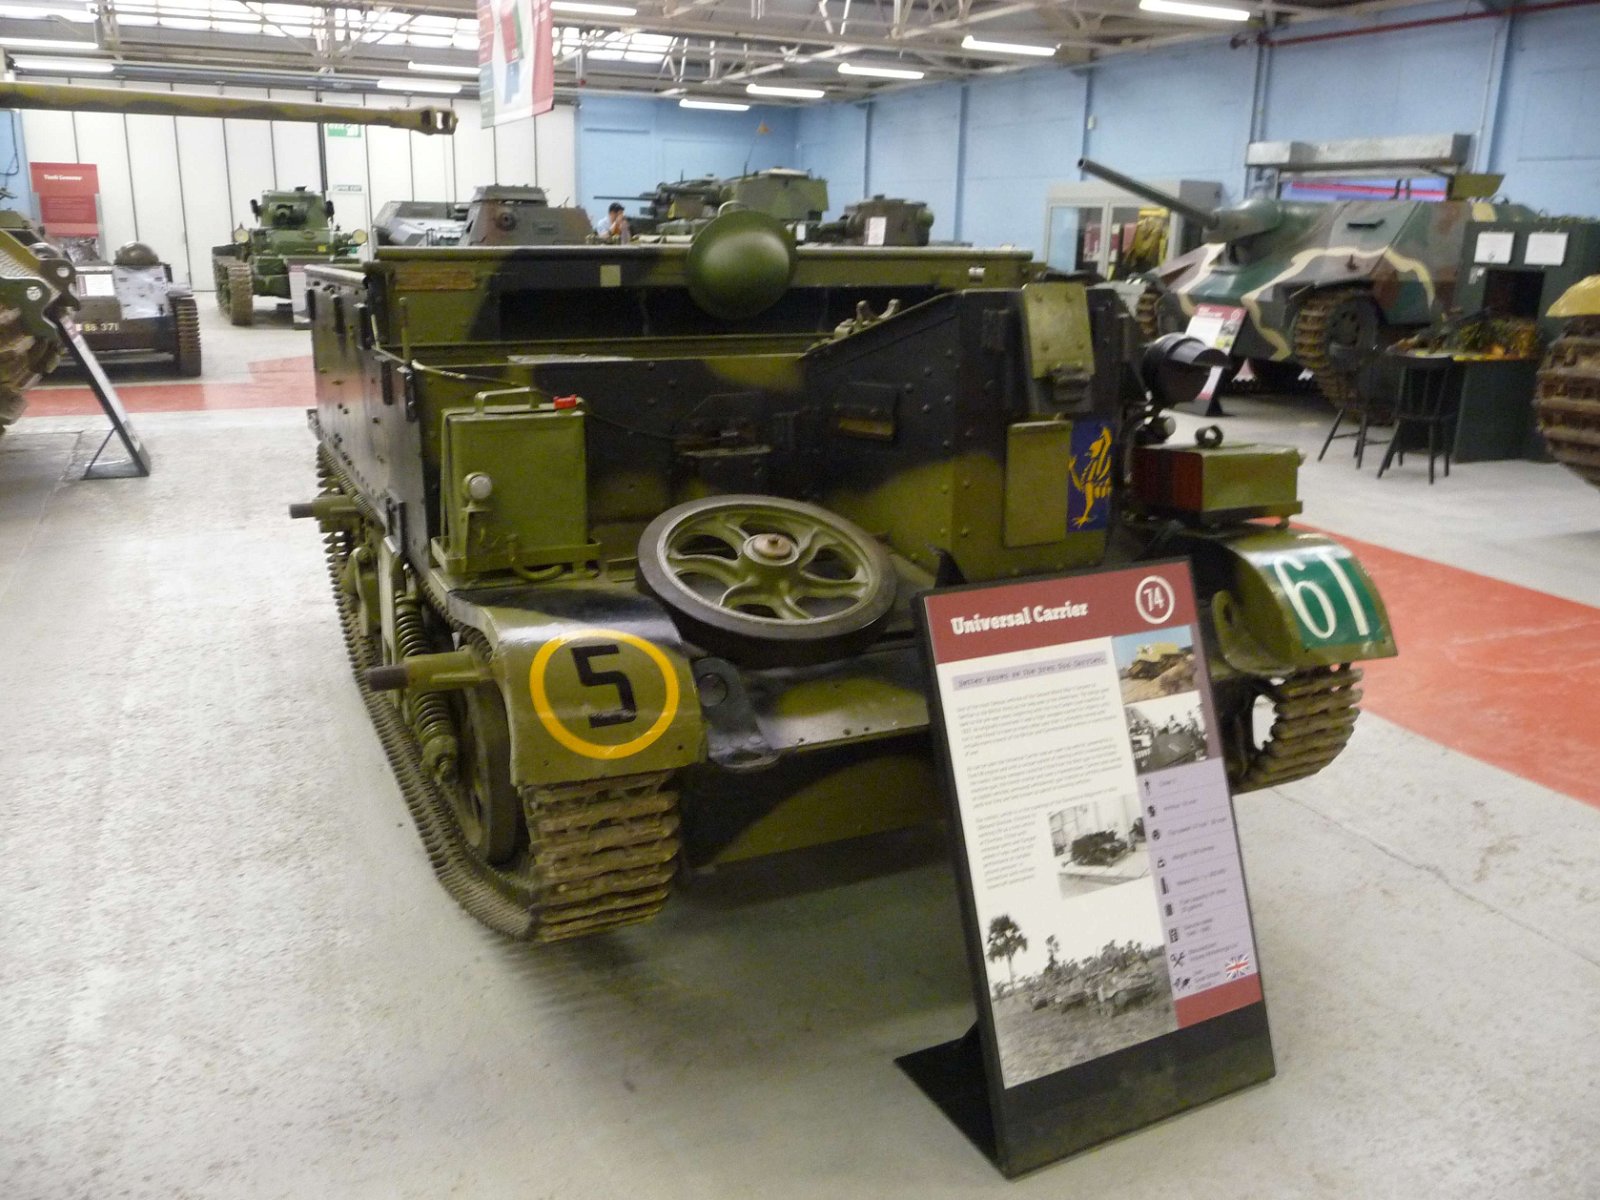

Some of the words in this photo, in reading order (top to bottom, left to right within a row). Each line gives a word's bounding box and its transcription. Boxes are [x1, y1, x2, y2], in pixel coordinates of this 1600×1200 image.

[1143, 586, 1165, 612] 74
[950, 607, 1031, 636] Universal
[1033, 600, 1088, 624] Carrier
[570, 644, 637, 728] 5
